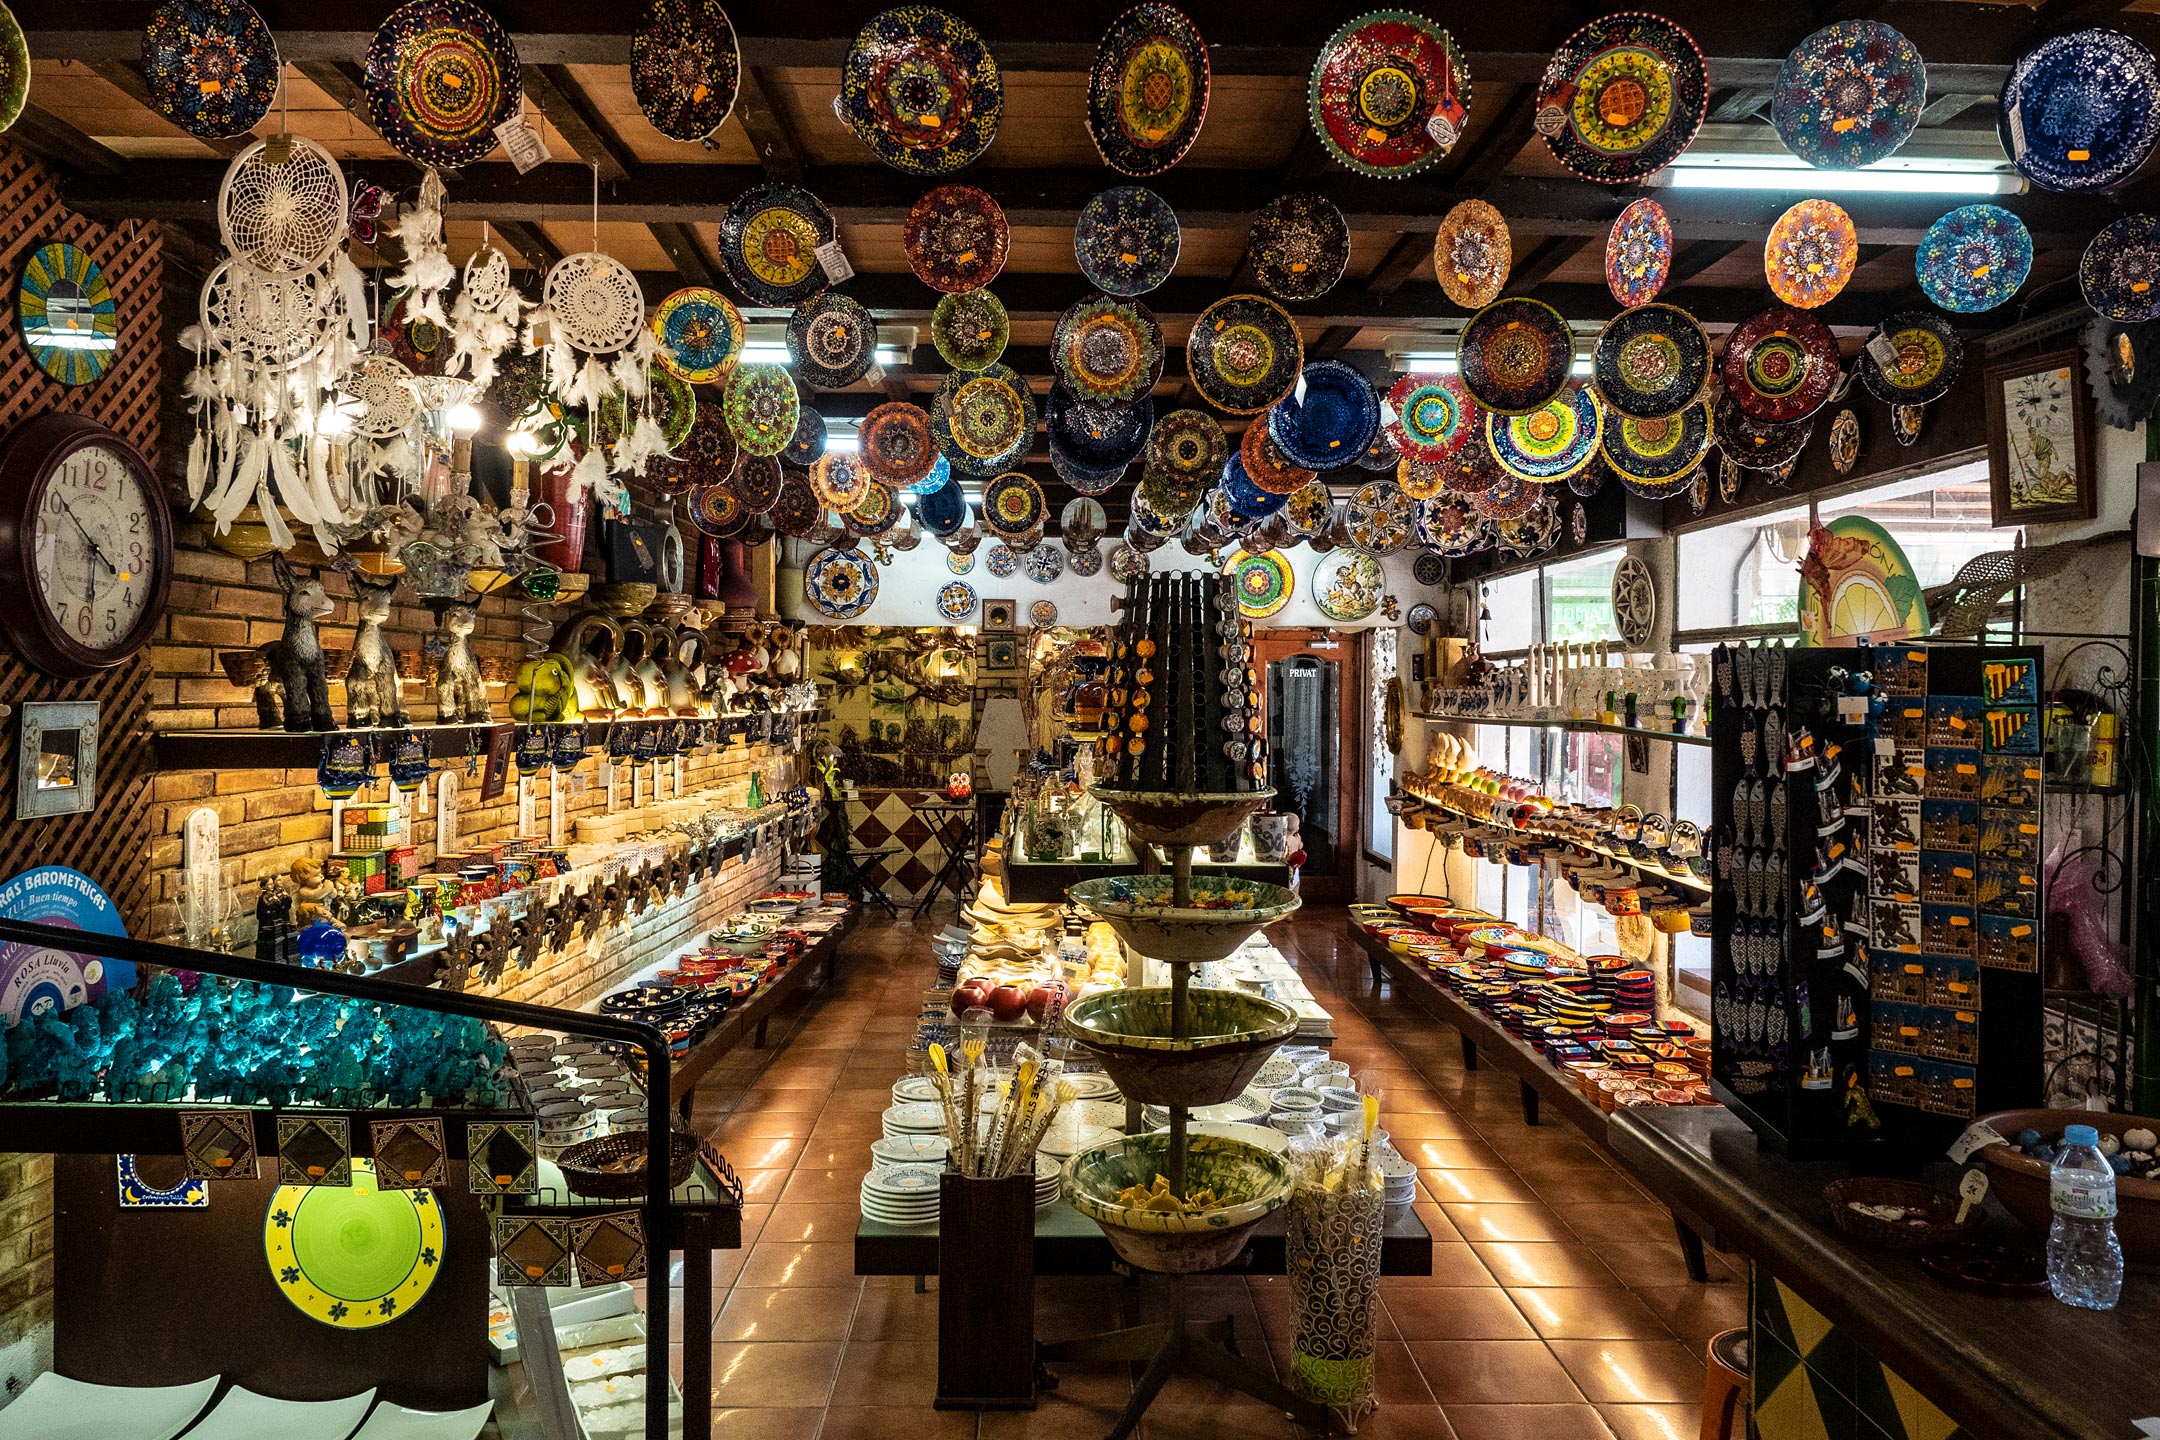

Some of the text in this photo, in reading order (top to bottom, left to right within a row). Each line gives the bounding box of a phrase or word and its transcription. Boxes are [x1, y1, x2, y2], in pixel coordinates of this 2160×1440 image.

[61, 462, 78, 487] 11
[83, 458, 107, 491] 12
[43, 491, 62, 514] 10
[117, 479, 124, 501] 1
[129, 512, 140, 534] 2
[128, 541, 143, 575] 3
[39, 565, 49, 594] 8
[122, 586, 133, 608] 4
[57, 602, 68, 624] 7
[78, 605, 92, 636] 6
[105, 609, 116, 631] 5
[1289, 668, 1317, 678] PRIVAT
[3, 899, 27, 919] ZUL
[29, 893, 51, 906] Buen
[52, 890, 79, 908] tiempo
[24, 871, 107, 911] BAROMETRICAS
[14, 954, 70, 988] ROSA Lluvia
[1047, 983, 1065, 1038] PERFECT
[1002, 1065, 1021, 1117] PERFECT
[2061, 1190, 2095, 1203] Estrella
